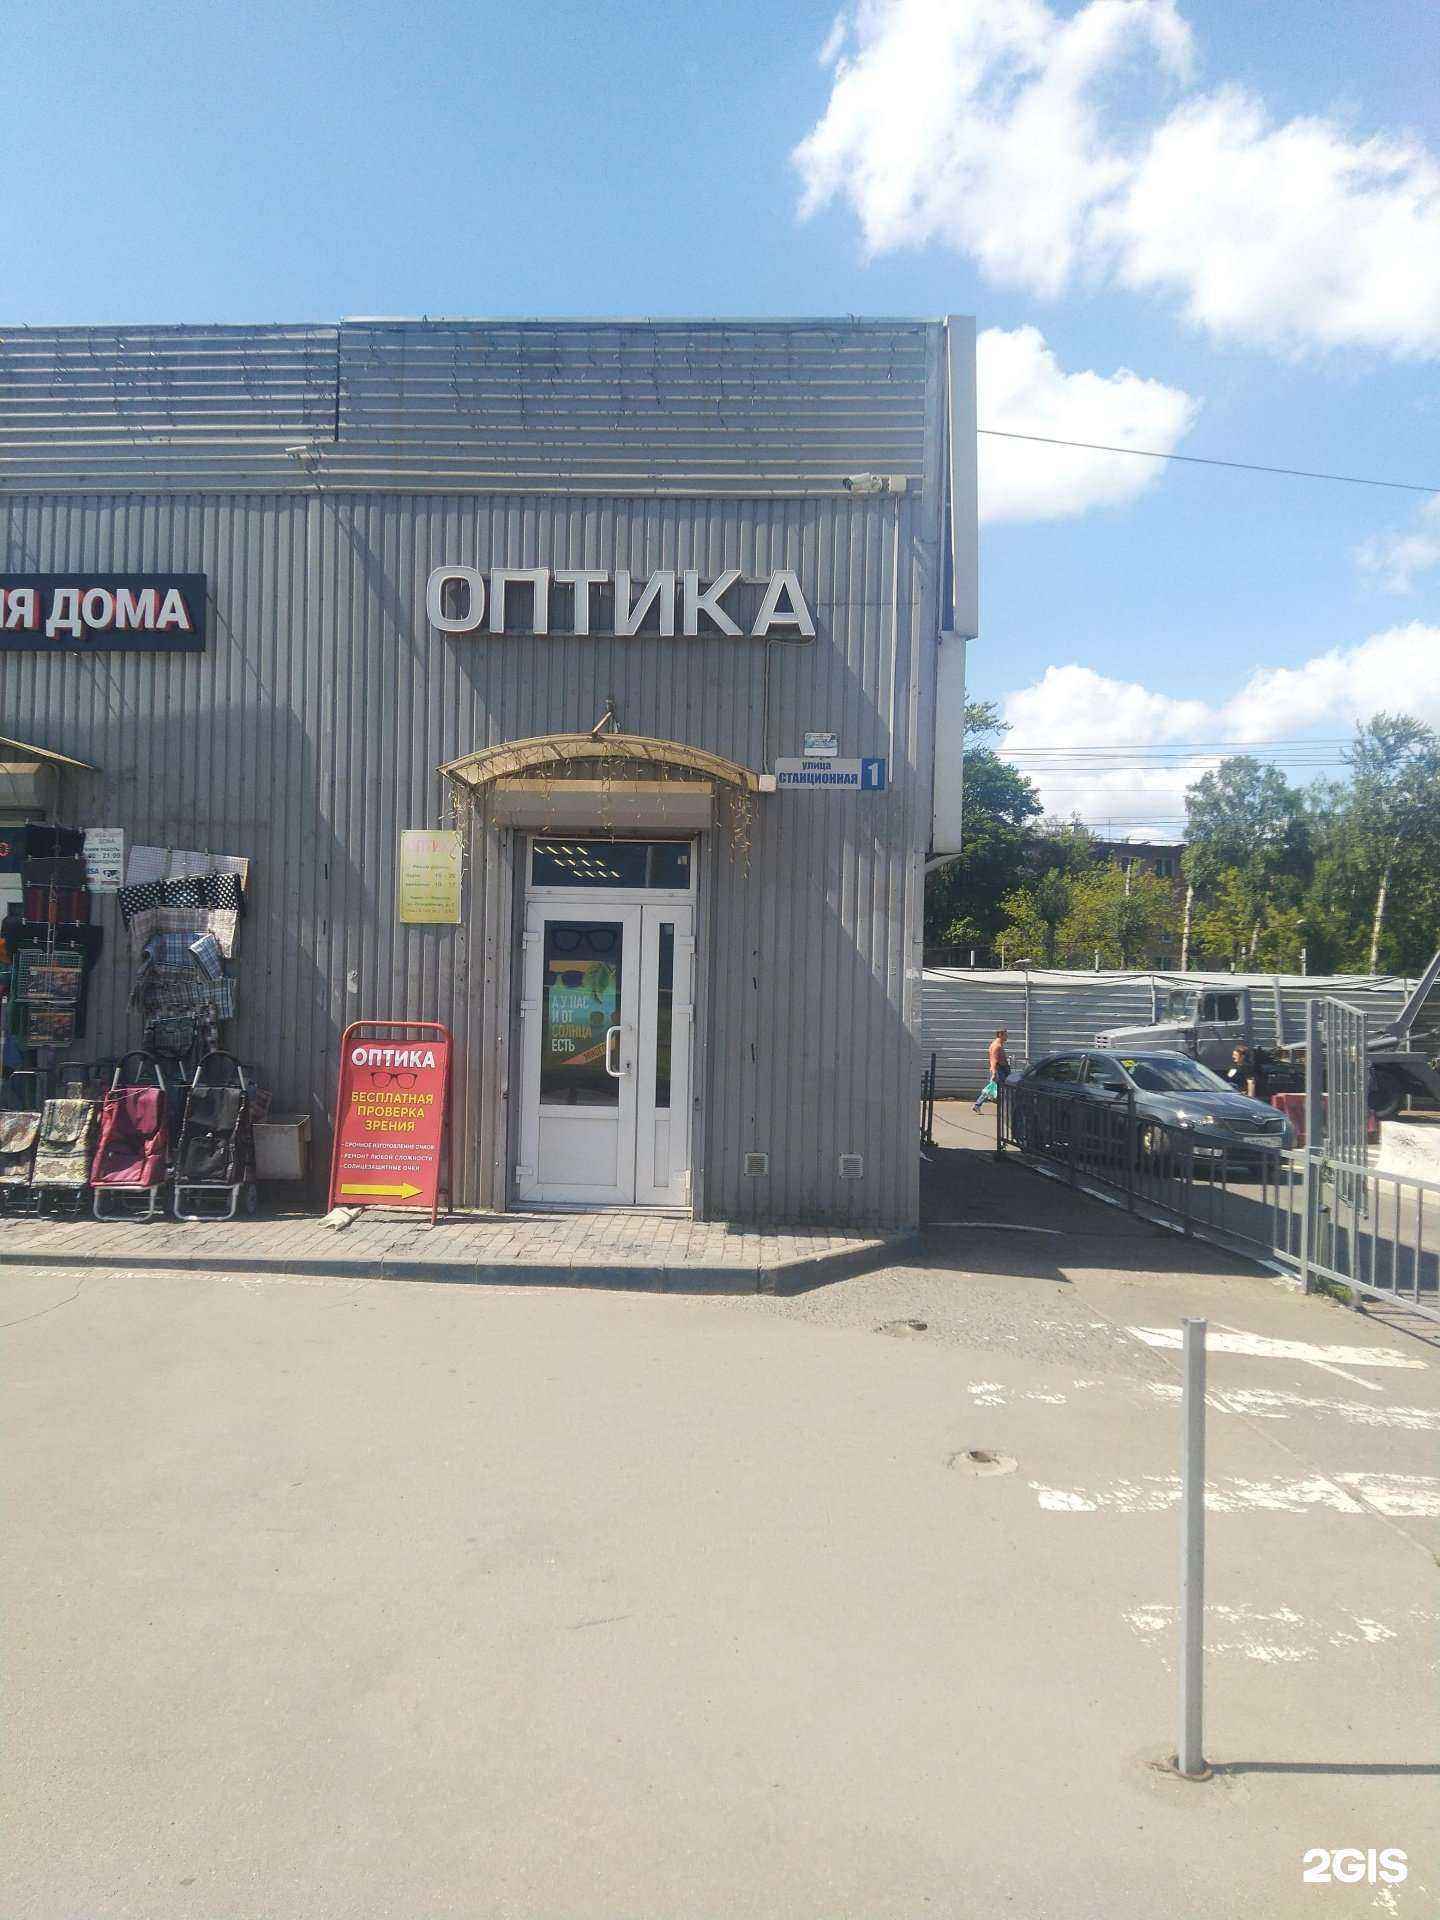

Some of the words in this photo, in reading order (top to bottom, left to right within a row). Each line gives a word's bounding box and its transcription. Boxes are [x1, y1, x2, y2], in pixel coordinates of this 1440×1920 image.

[426, 565, 816, 637] ОПТИКА
[0, 588, 34, 628] Я
[45, 587, 190, 637] ДОМА
[802, 761, 831, 770] улица
[779, 772, 858, 785] СТАНЦИОННАЯ
[868, 763, 878, 786] 1
[552, 1038, 575, 1052] ЕСТЬ
[352, 1047, 435, 1068] ОПТИКА
[352, 1091, 433, 1104] БЕСПЛАТНАЯ
[357, 1105, 424, 1118] ПРОВЕРКА
[365, 1120, 415, 1131] ЗРЕНИЯ
